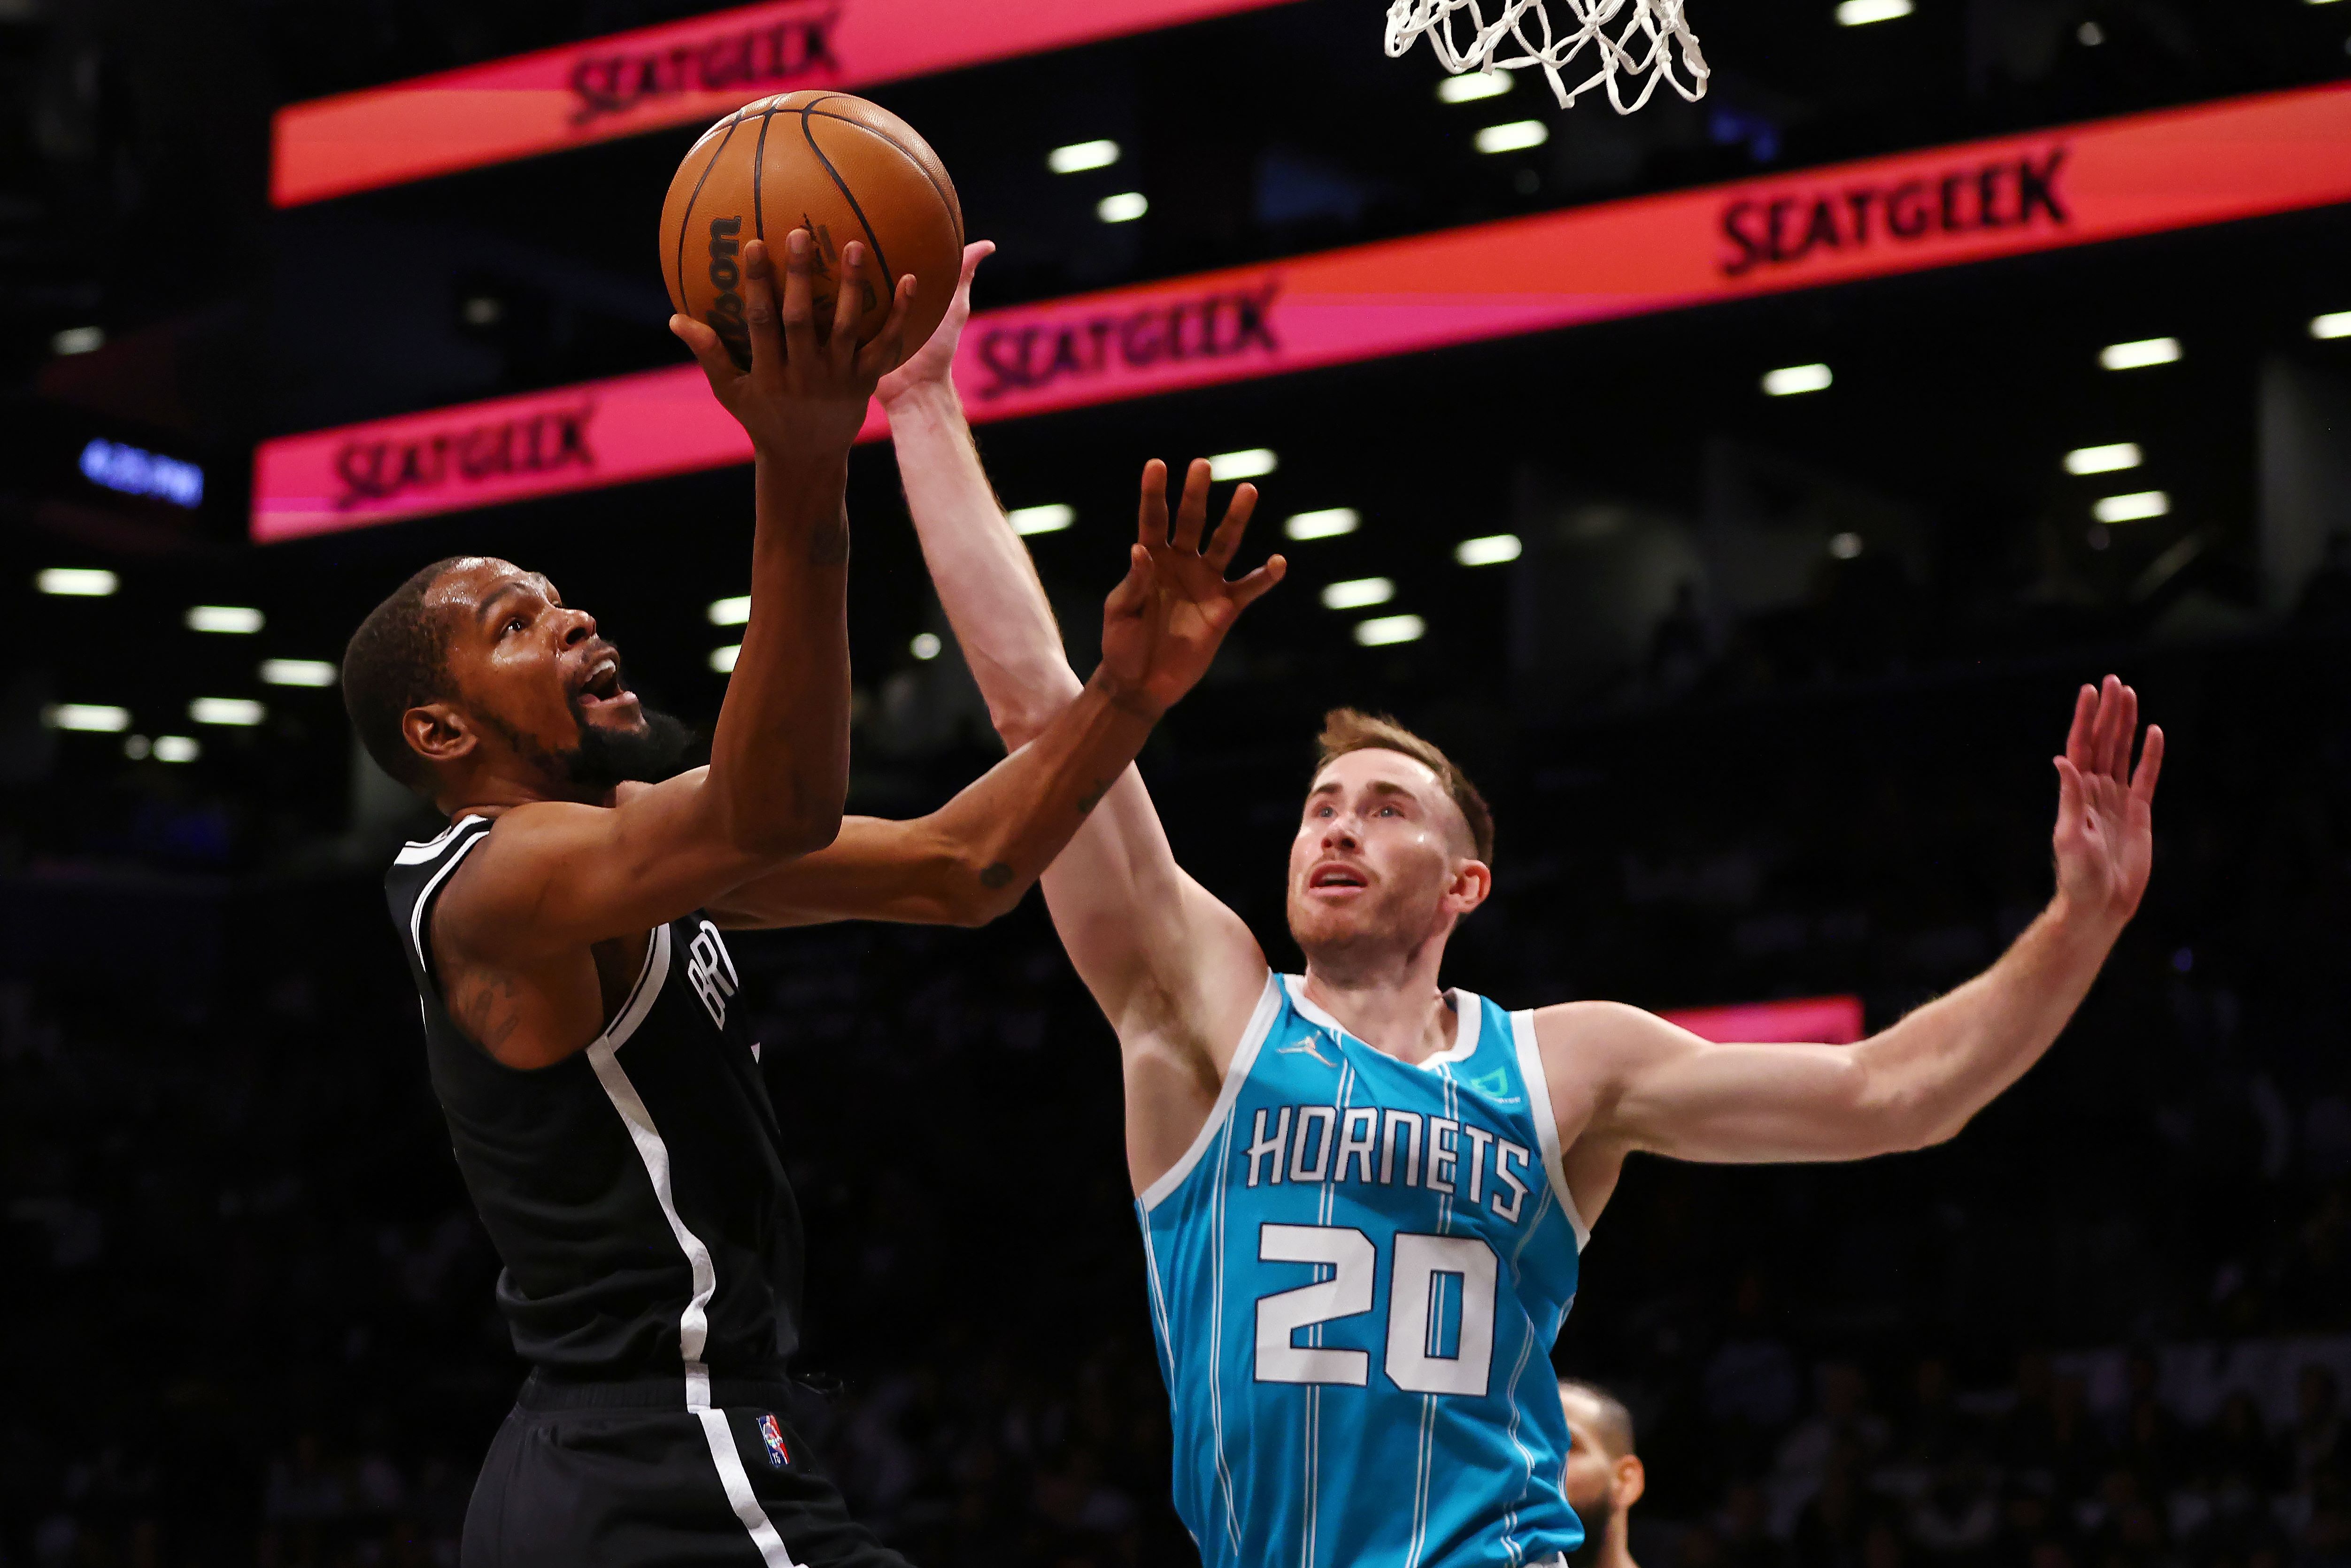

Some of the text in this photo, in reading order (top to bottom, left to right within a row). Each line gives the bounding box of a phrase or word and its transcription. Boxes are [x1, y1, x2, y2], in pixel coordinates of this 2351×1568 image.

[571, 9, 840, 124] SEATGEEK
[1720, 149, 2068, 275] SEATGEEK
[979, 284, 1278, 399] SEATGEEK
[335, 399, 594, 511] SEATGEEK
[1244, 1105, 1530, 1223] HORNETS
[1253, 1222, 1499, 1397] 20
